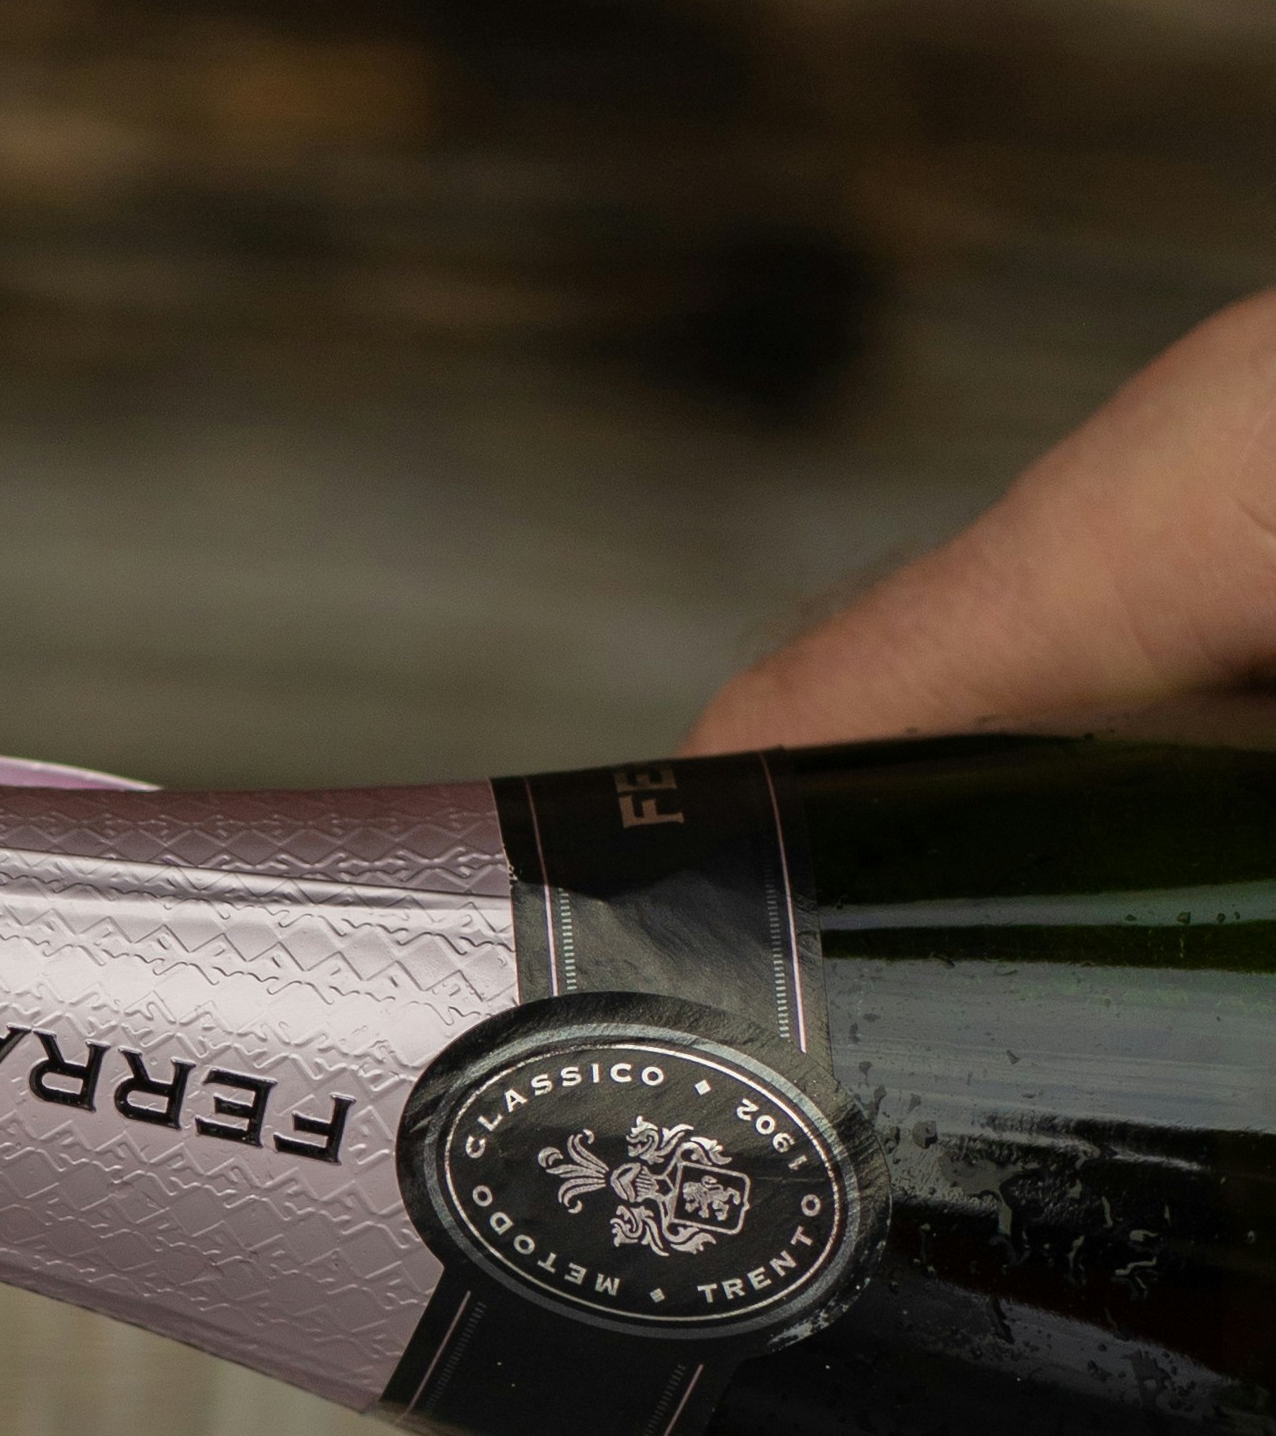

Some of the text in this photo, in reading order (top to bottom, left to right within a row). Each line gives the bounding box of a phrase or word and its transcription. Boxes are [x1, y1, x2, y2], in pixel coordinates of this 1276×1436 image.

[465, 1063, 665, 1297] METODO CLASSICO
[697, 1099, 822, 1304] TRENTO 1902
